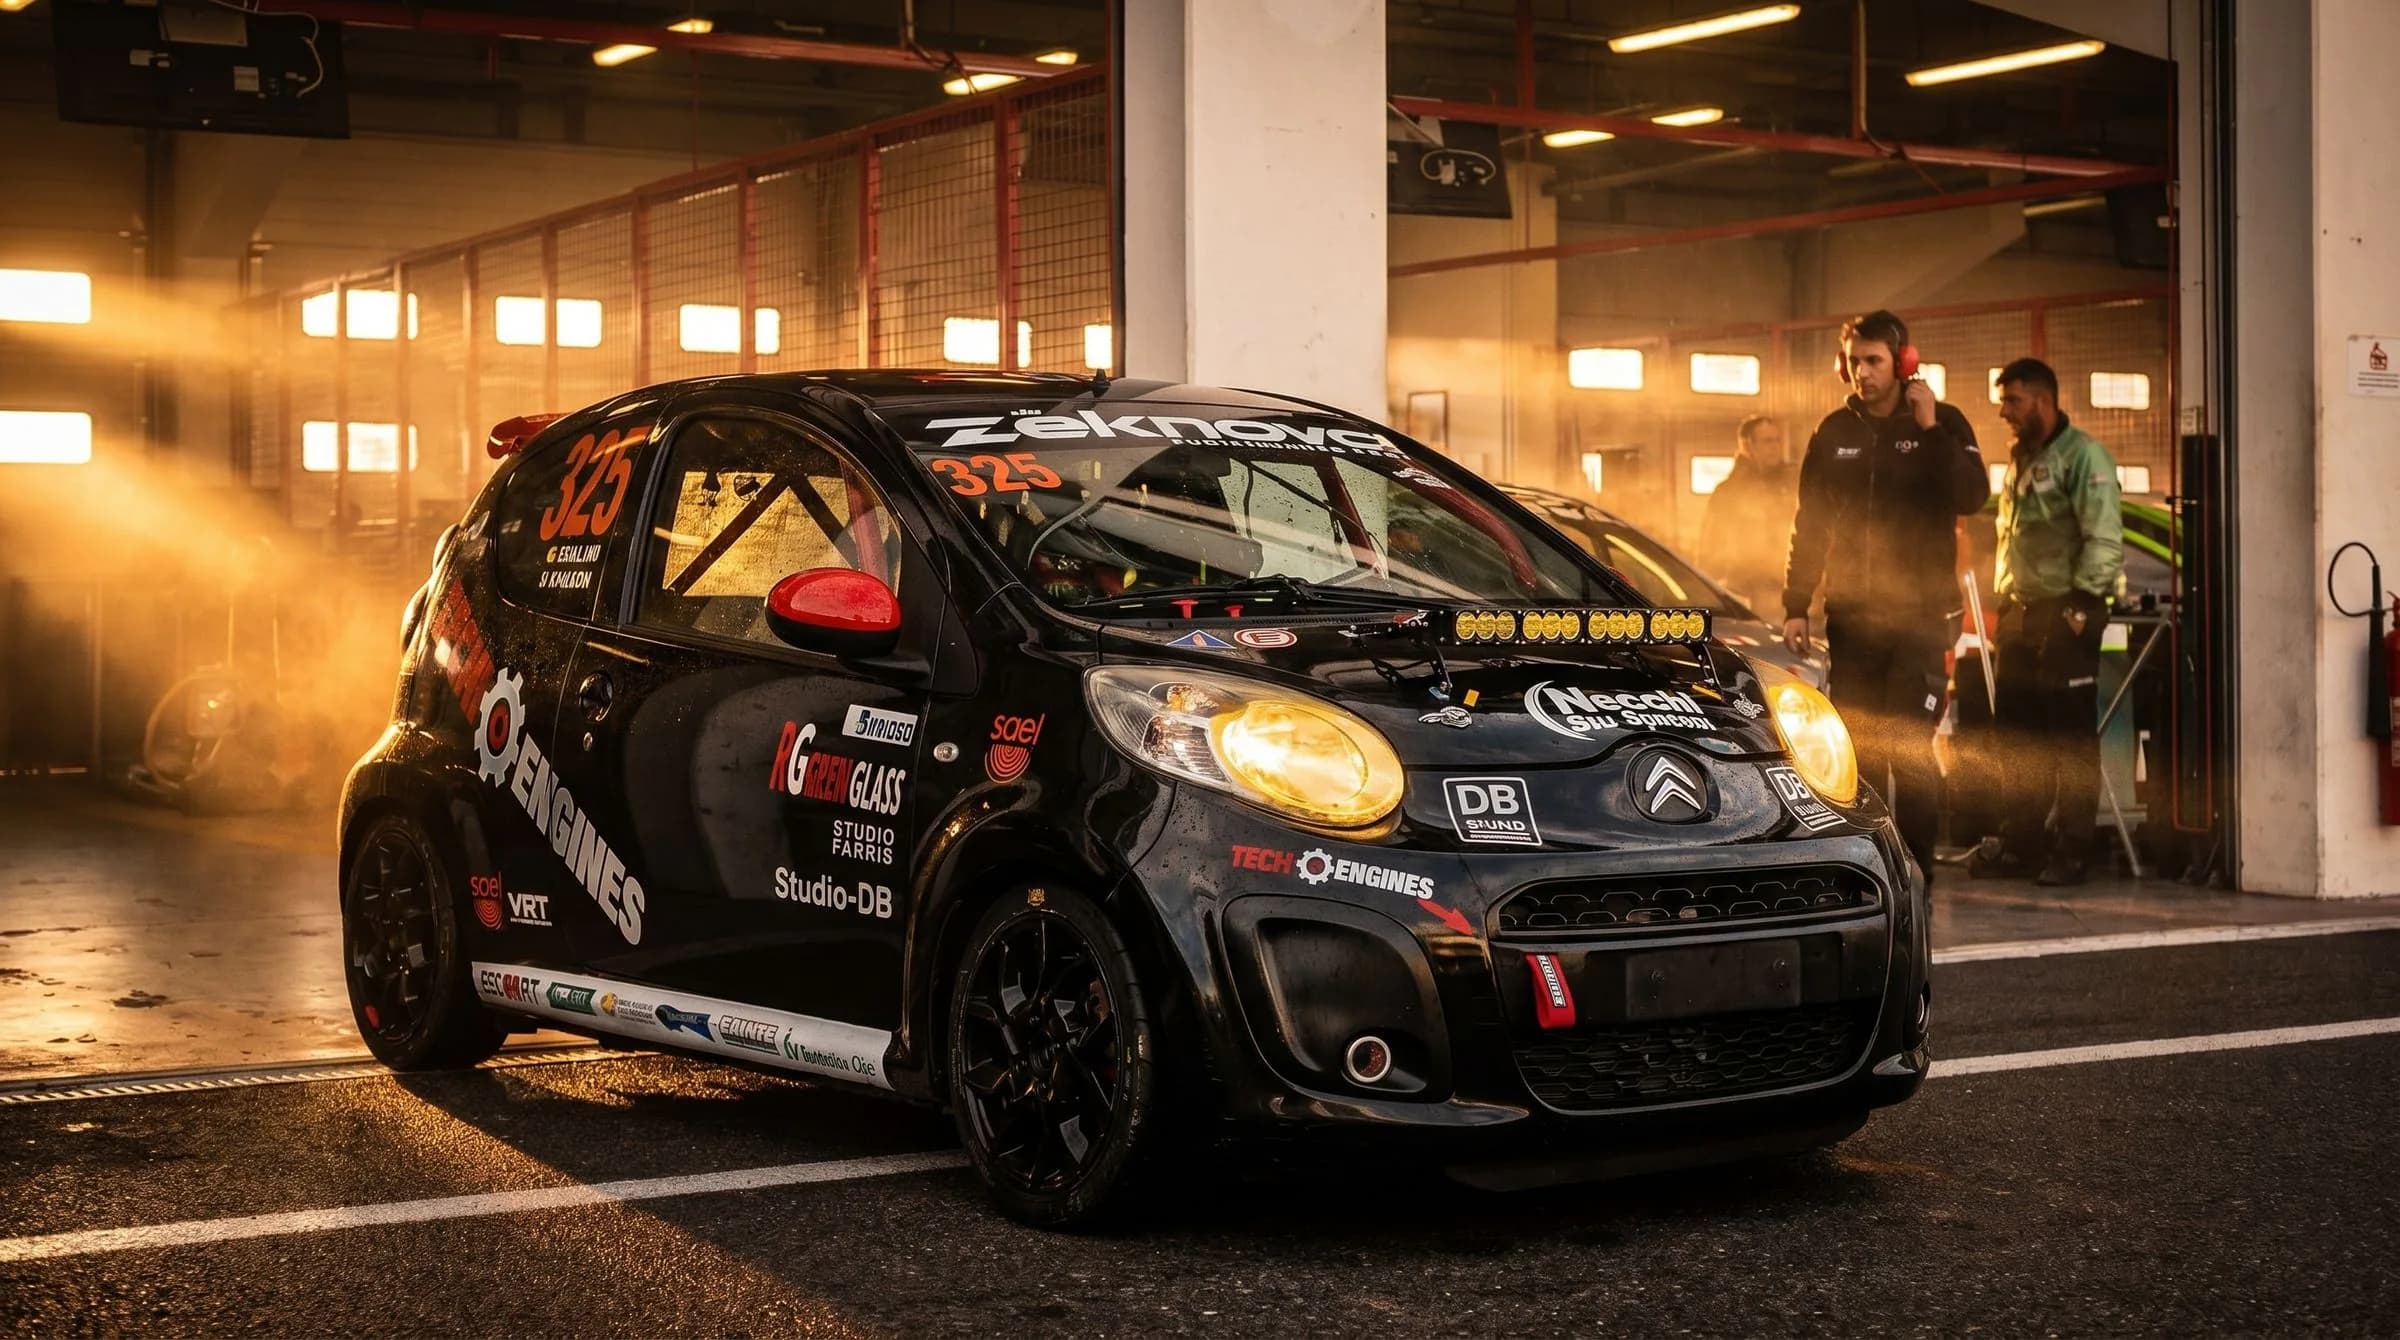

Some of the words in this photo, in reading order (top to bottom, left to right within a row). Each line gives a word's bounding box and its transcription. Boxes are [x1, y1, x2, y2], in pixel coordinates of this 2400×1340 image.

[540, 425, 650, 541] 325
[932, 453, 1062, 496] 325
[1456, 784, 1520, 815] DB
[1773, 773, 1811, 800] DB
[510, 732, 645, 946] ENGINES
[832, 837, 893, 865] FARRIS
[833, 819, 895, 846] STUDIO
[1231, 845, 1296, 875] TECH
[1333, 858, 1434, 900] ENGINES
[507, 891, 549, 920] VRT
[775, 866, 892, 919] Studio-DB
